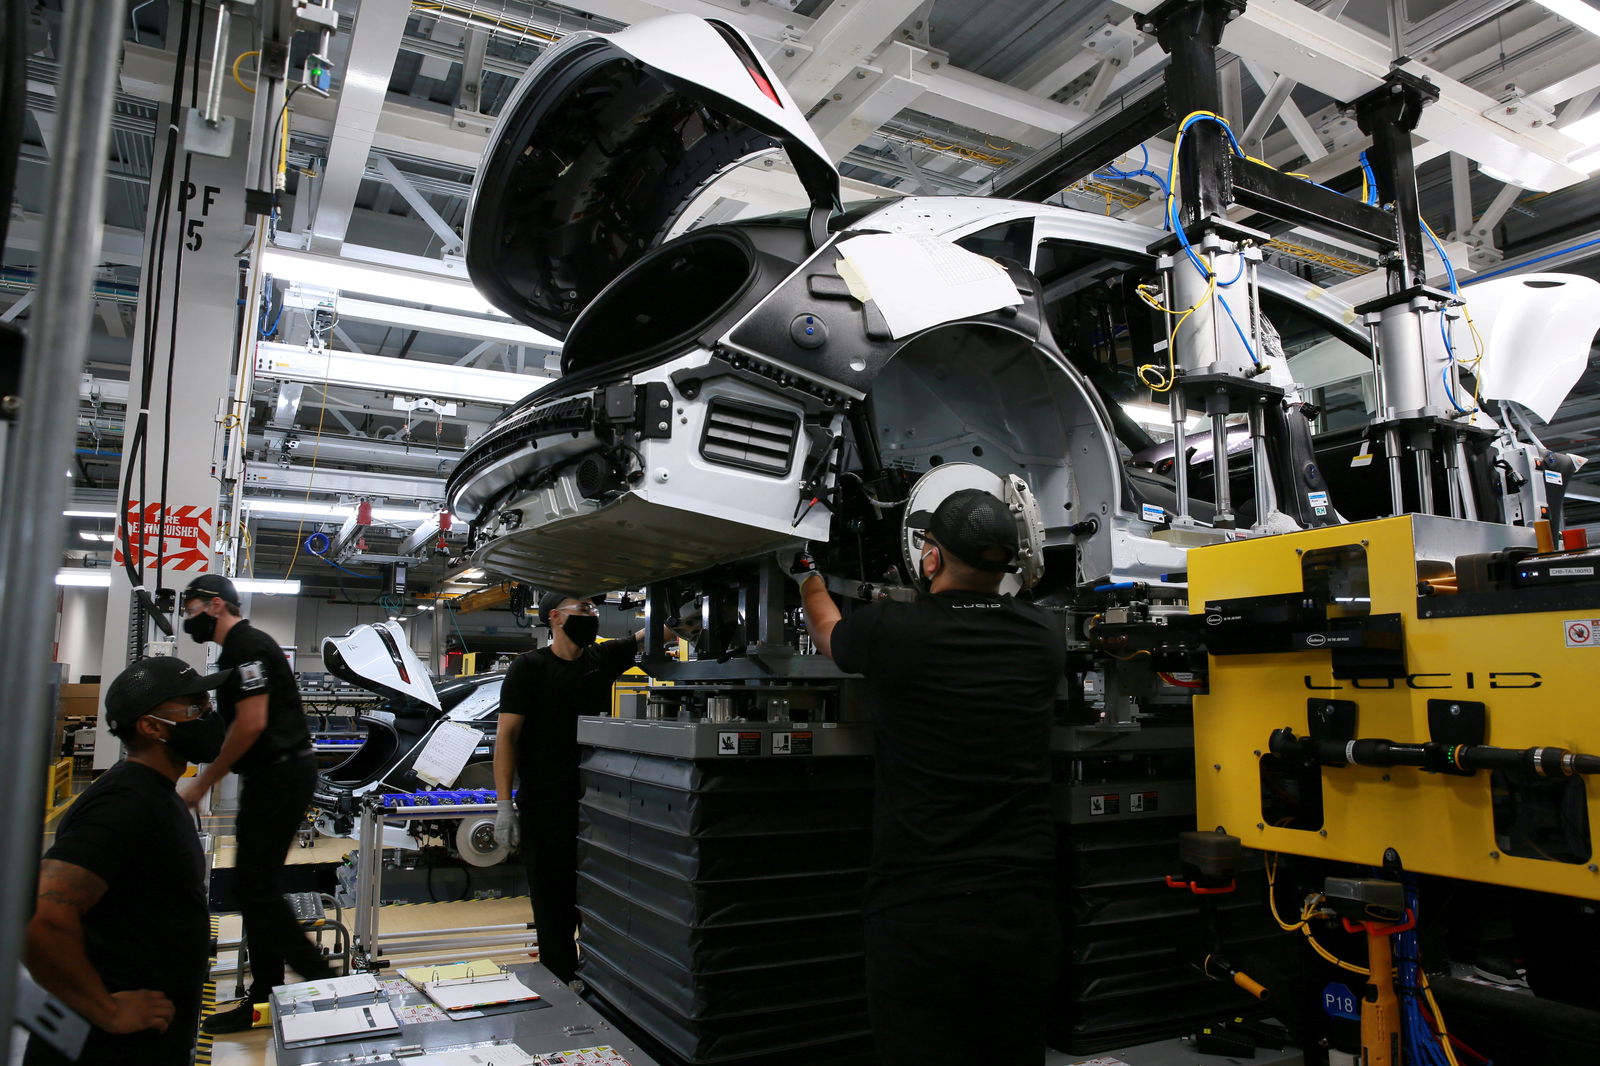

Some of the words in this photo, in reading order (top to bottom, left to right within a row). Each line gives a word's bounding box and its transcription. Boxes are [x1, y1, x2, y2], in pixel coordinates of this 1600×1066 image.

[186, 219, 204, 252] 5
[154, 514, 180, 525] FRE
[1316, 507, 1326, 515] RH
[1304, 672, 1542, 689] LUCID
[1325, 993, 1353, 1013] P18
